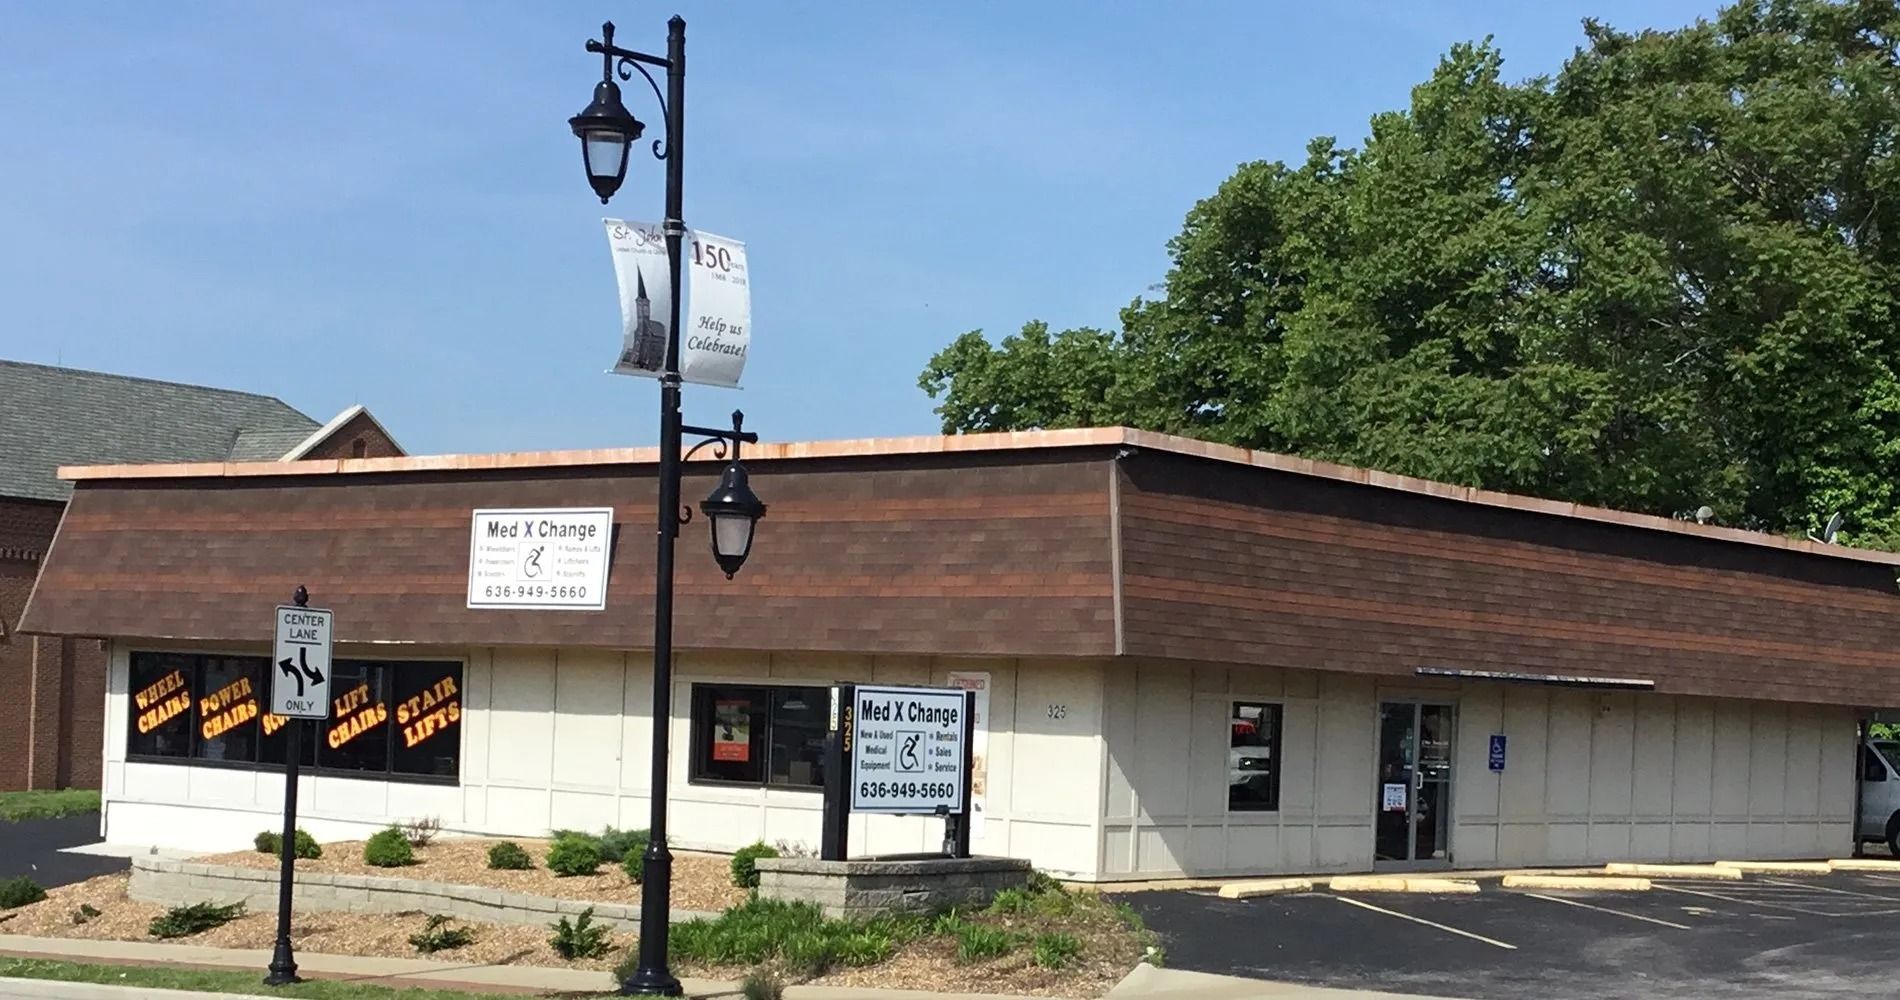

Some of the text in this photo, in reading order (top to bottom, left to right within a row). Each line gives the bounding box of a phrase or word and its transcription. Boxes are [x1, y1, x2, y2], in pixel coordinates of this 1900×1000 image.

[692, 241, 731, 272] 150
[698, 316, 743, 336] Help us
[688, 336, 747, 357] Celebrate!
[487, 520, 596, 541] Med X Change
[485, 585, 587, 598] 636-949-5660
[284, 614, 325, 627] CENTER
[289, 628, 318, 640] LANE
[135, 669, 185, 710] WHEEL
[200, 676, 252, 717] POWER
[286, 700, 314, 711] ONLY
[334, 684, 370, 718] LIFT
[397, 676, 458, 724] STAIR
[138, 690, 190, 734] CHAIRS
[202, 699, 258, 741] CHAIRS
[861, 699, 890, 721] Med
[894, 701, 904, 722] X
[908, 701, 958, 728] Change
[1047, 704, 1066, 719] 325
[328, 703, 388, 749] CHAIRS
[403, 701, 460, 748] LIFTS
[843, 705, 852, 752] 325
[860, 730, 872, 740] New
[880, 730, 893, 740] Used
[935, 731, 958, 742] Rentals
[865, 745, 887, 755] Medical
[935, 747, 951, 757] Sales
[860, 760, 890, 771] Equipment
[934, 762, 957, 772] Service
[860, 782, 954, 798] 636-949-5660
